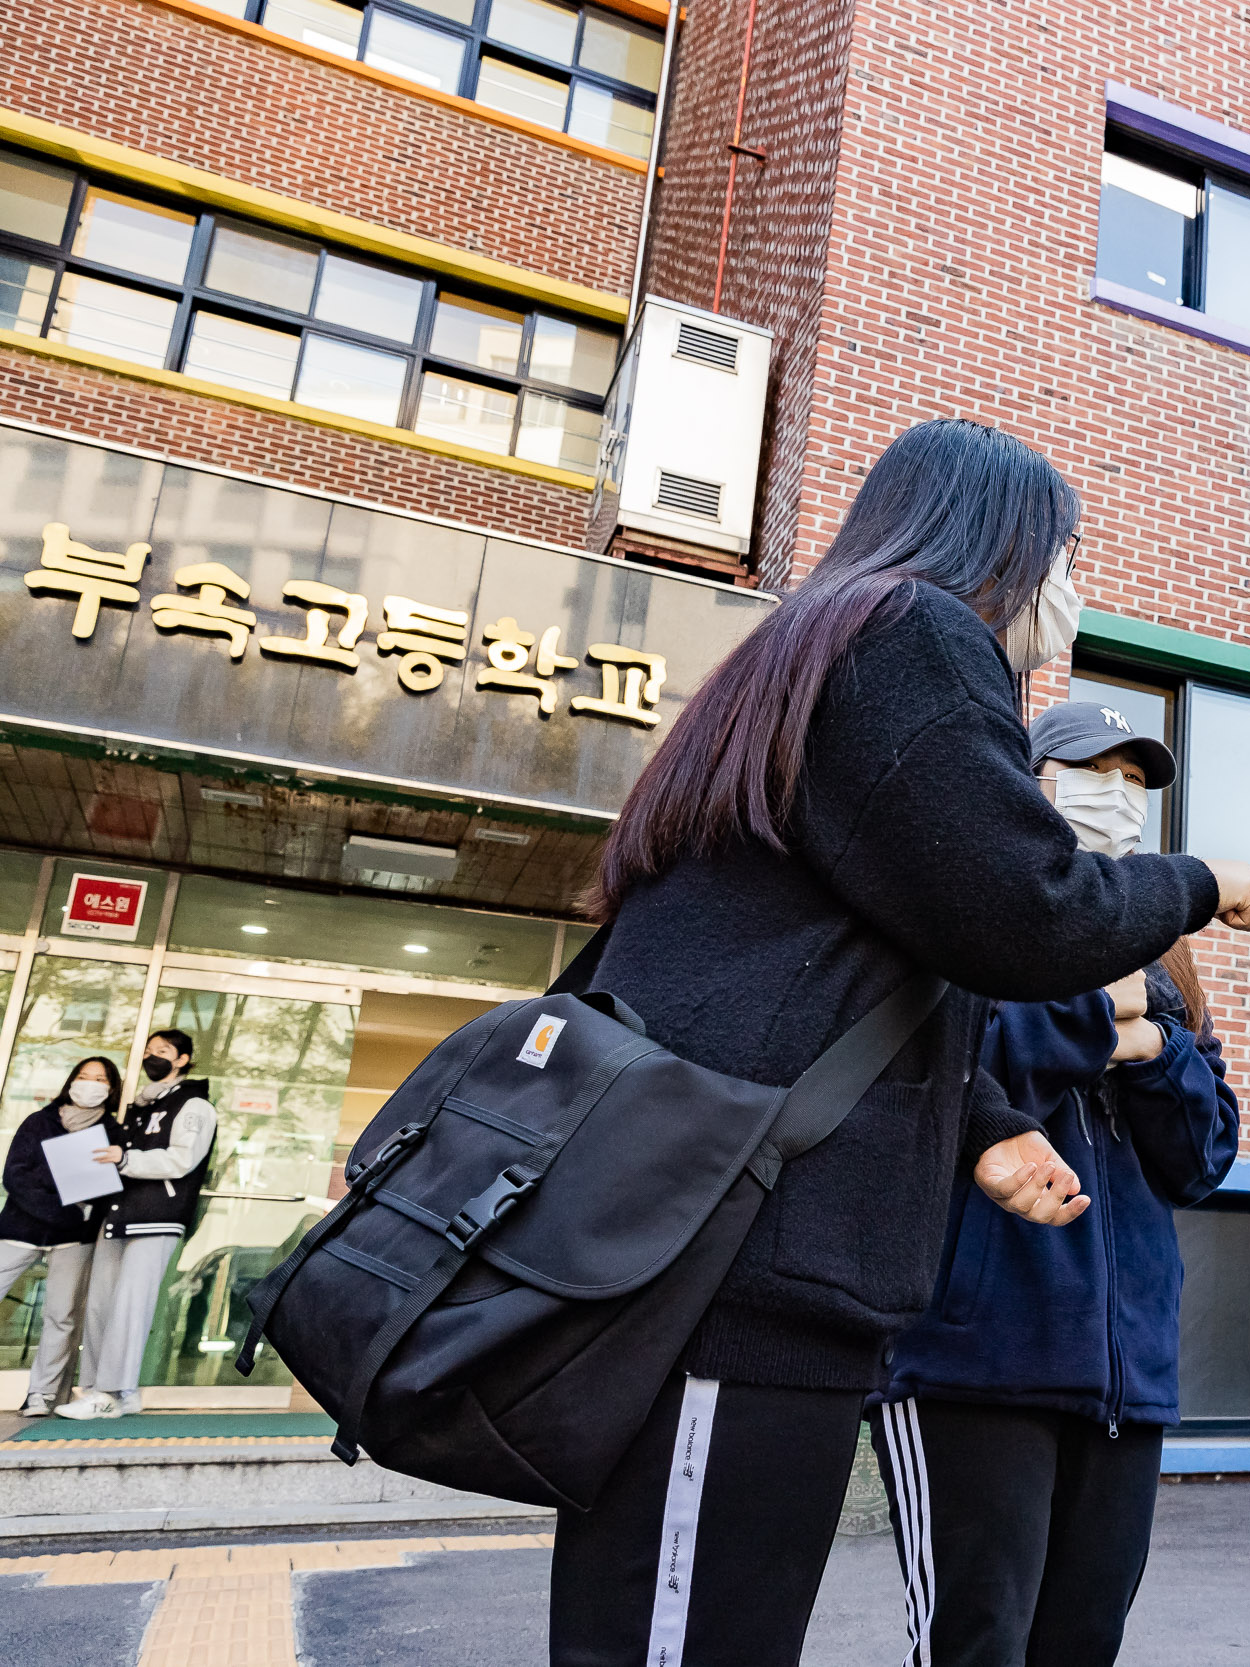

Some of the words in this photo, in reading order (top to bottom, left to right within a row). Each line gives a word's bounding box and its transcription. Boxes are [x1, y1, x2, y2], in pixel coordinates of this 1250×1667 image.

[23, 522, 668, 727] 부속고등학교
[84, 893, 131, 913] 에스원
[144, 1111, 168, 1135] K
[685, 1432, 696, 1461] balance
